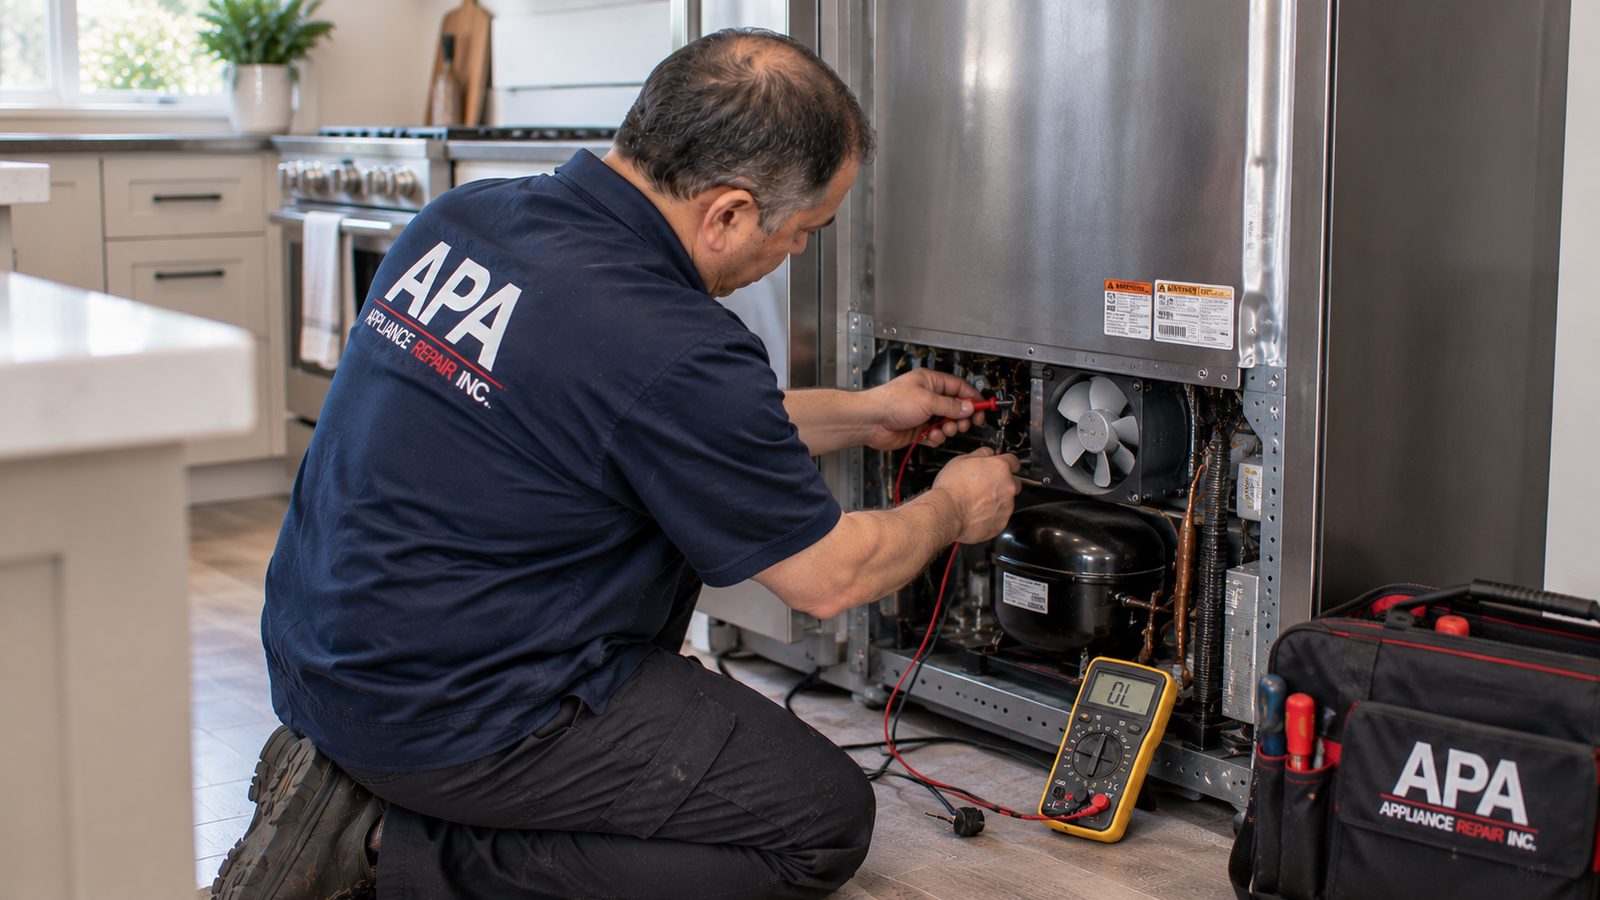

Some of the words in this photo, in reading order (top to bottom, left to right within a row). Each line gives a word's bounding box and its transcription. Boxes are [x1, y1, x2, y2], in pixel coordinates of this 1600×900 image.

[384, 241, 522, 372] APA
[365, 308, 416, 349] APPLIANCE
[410, 340, 458, 381] REPAIR
[455, 370, 491, 408] INC.
[1379, 801, 1455, 832] APPLIANCE
[1456, 820, 1504, 843] REPAIR
[1507, 830, 1537, 851] INC.
[1392, 741, 1529, 826] APA
